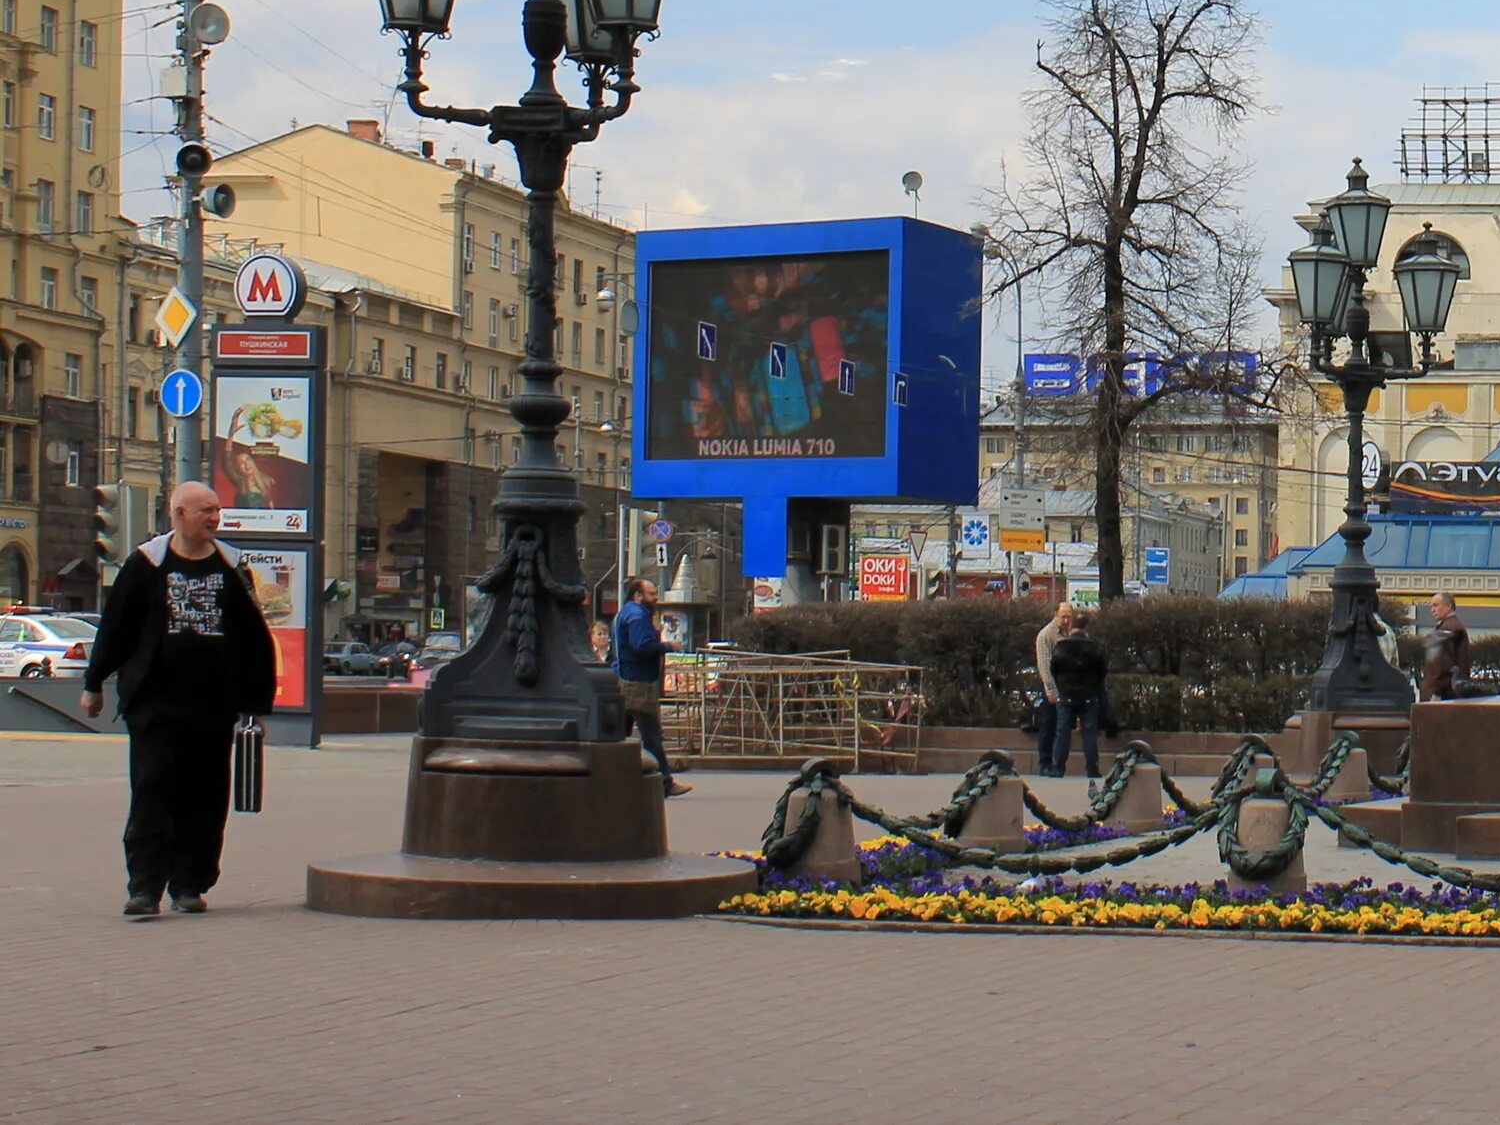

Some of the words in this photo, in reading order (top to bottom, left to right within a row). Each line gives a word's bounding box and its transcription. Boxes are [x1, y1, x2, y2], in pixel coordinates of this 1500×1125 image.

[247, 267, 283, 302] М
[699, 439, 749, 456] NOKIA
[753, 438, 802, 455] LUMIA
[806, 438, 836, 455] 710
[244, 553, 283, 564] Тейсти
[864, 558, 896, 573] ОКИ
